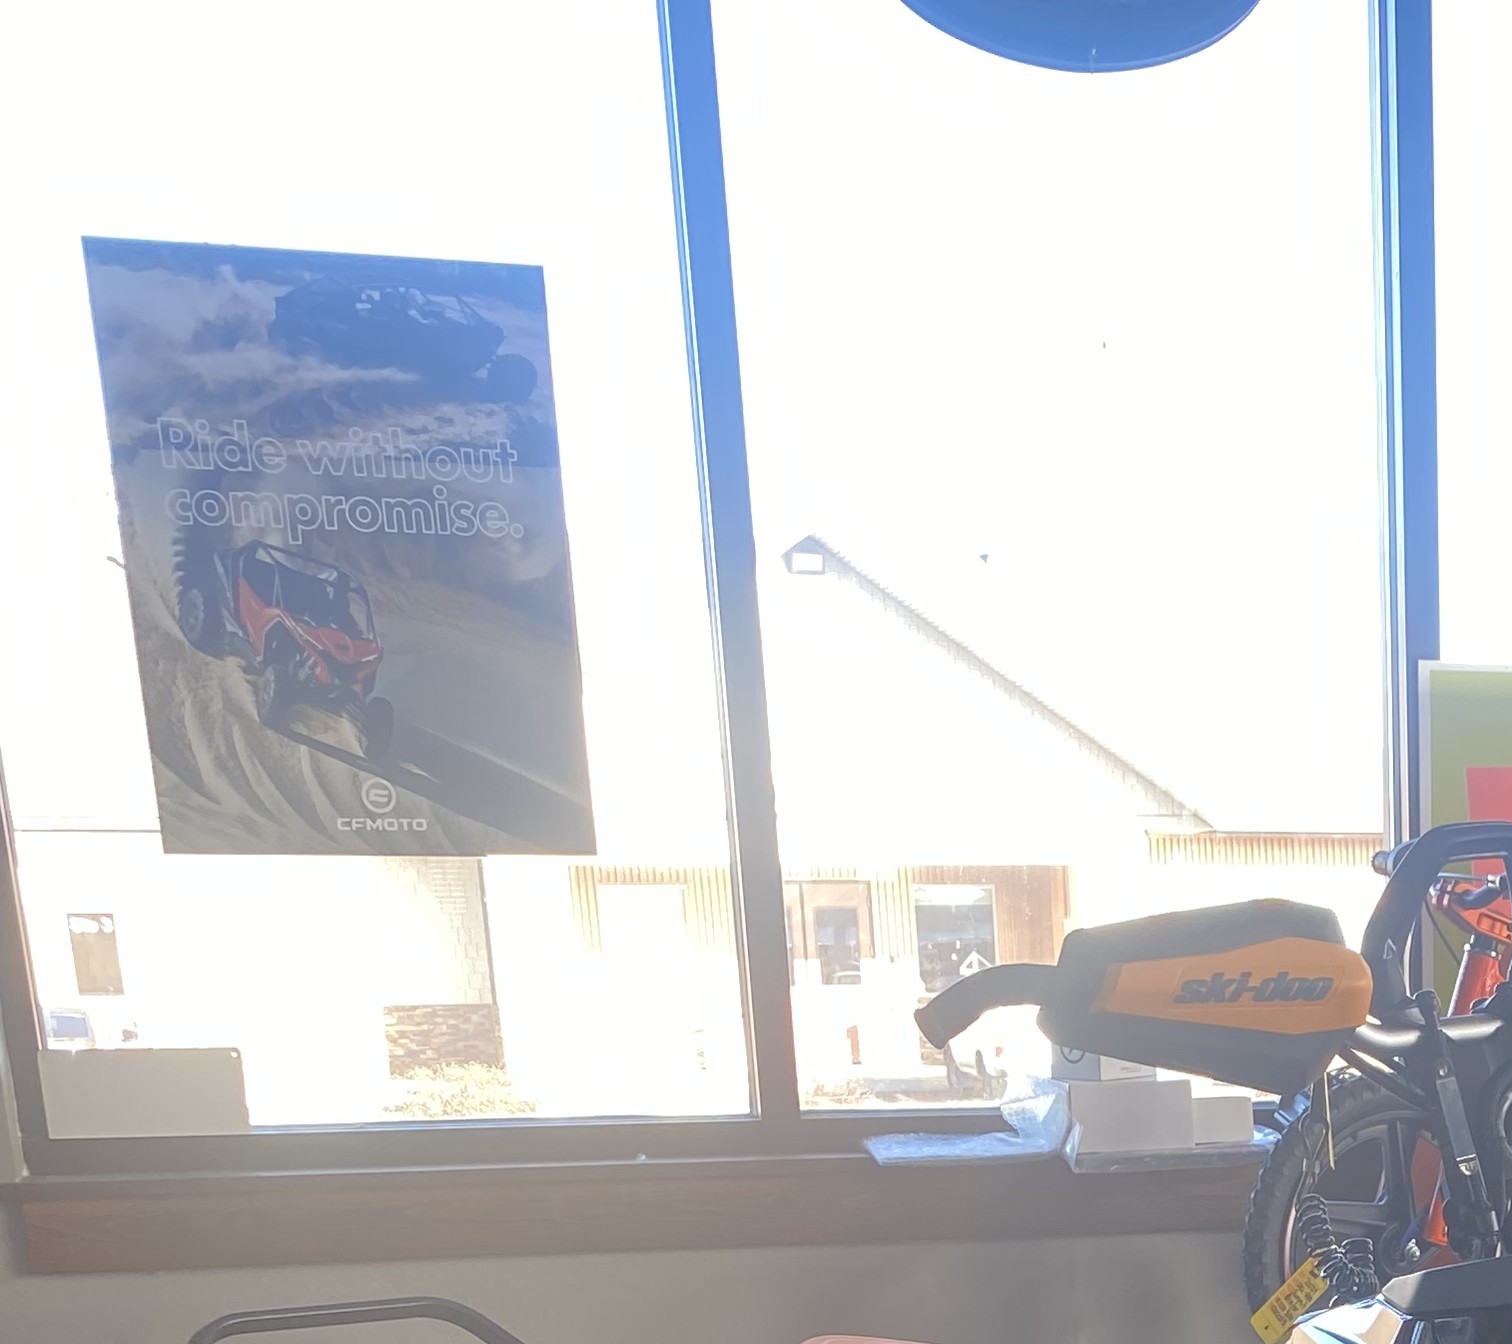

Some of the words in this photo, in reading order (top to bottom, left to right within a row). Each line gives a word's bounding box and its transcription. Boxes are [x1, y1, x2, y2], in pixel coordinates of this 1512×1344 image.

[157, 417, 287, 473] Ride
[296, 427, 517, 484] without
[165, 484, 525, 545] compromise.
[337, 817, 428, 832] CFMOTO
[1172, 971, 1335, 1004] ski-doo
